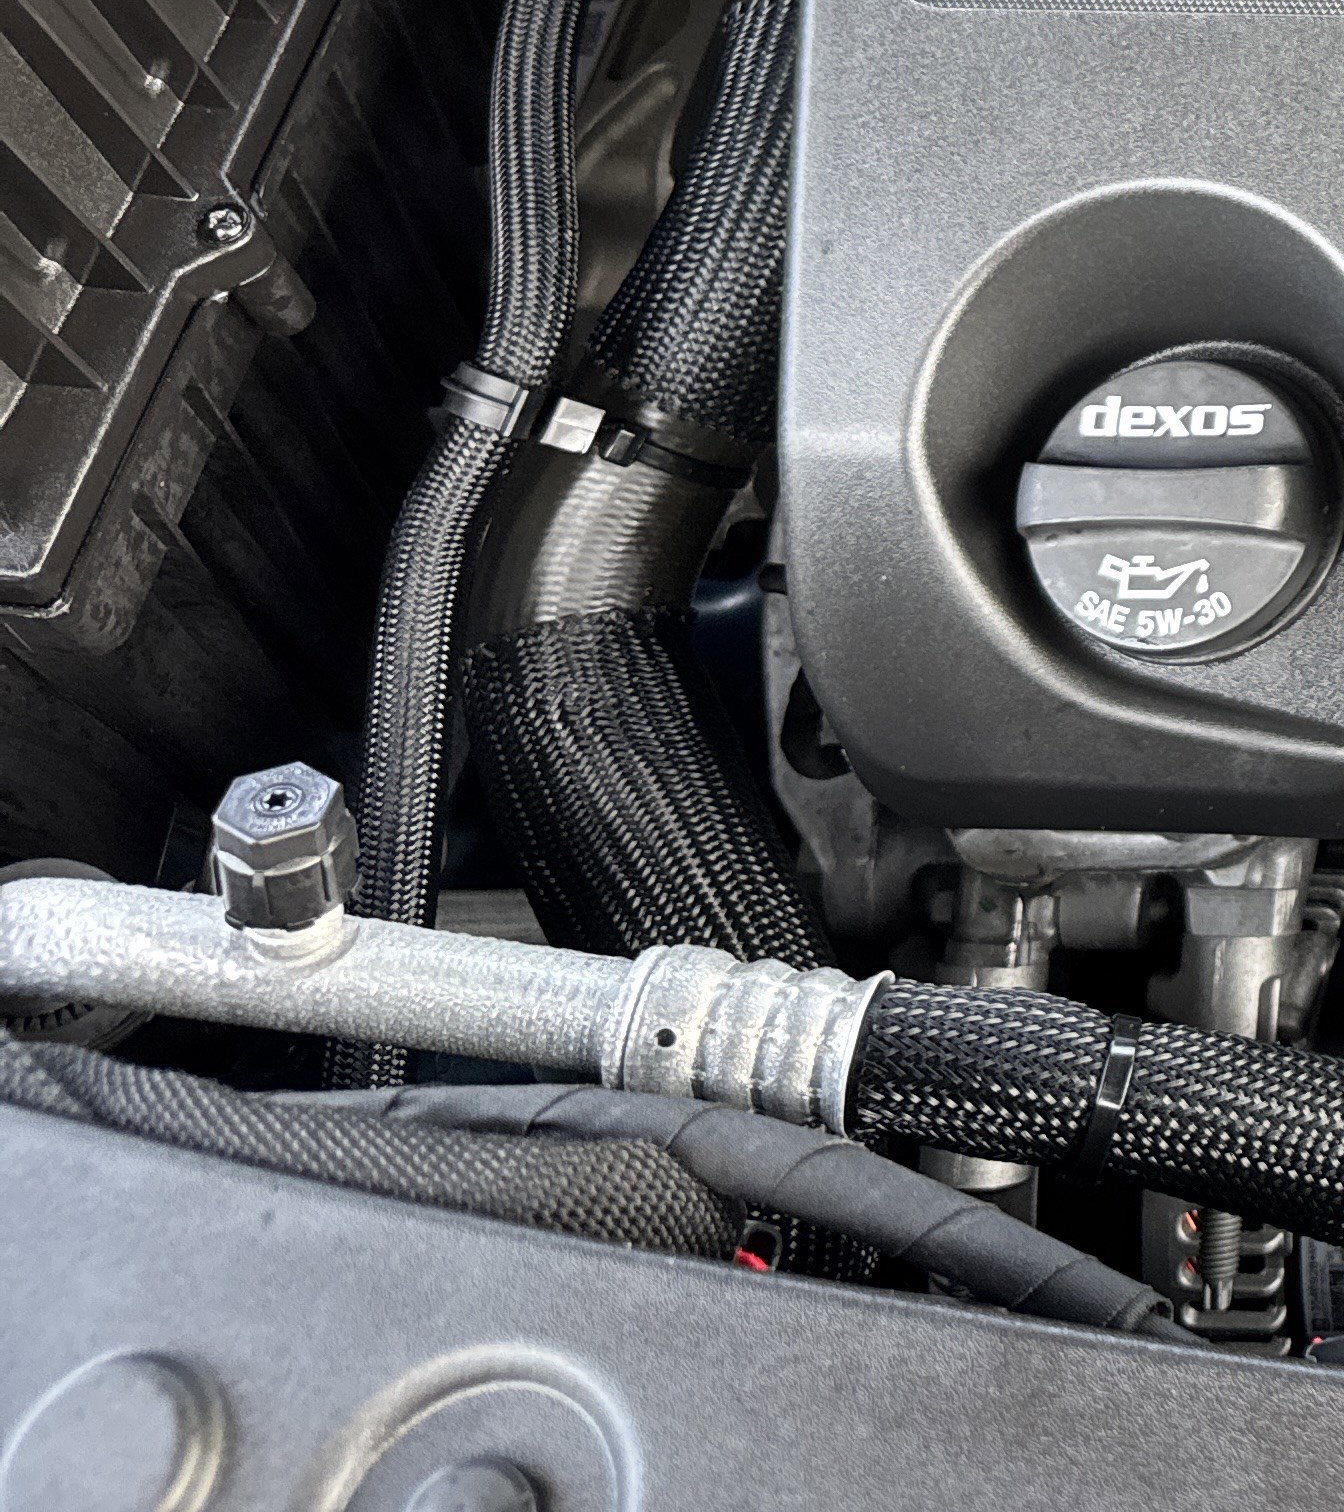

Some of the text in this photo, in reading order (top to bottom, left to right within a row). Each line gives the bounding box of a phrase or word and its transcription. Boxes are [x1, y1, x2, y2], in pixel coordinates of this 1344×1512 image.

[1079, 395, 1272, 438] dexos
[1074, 590, 1233, 637] SAE 5W-30
